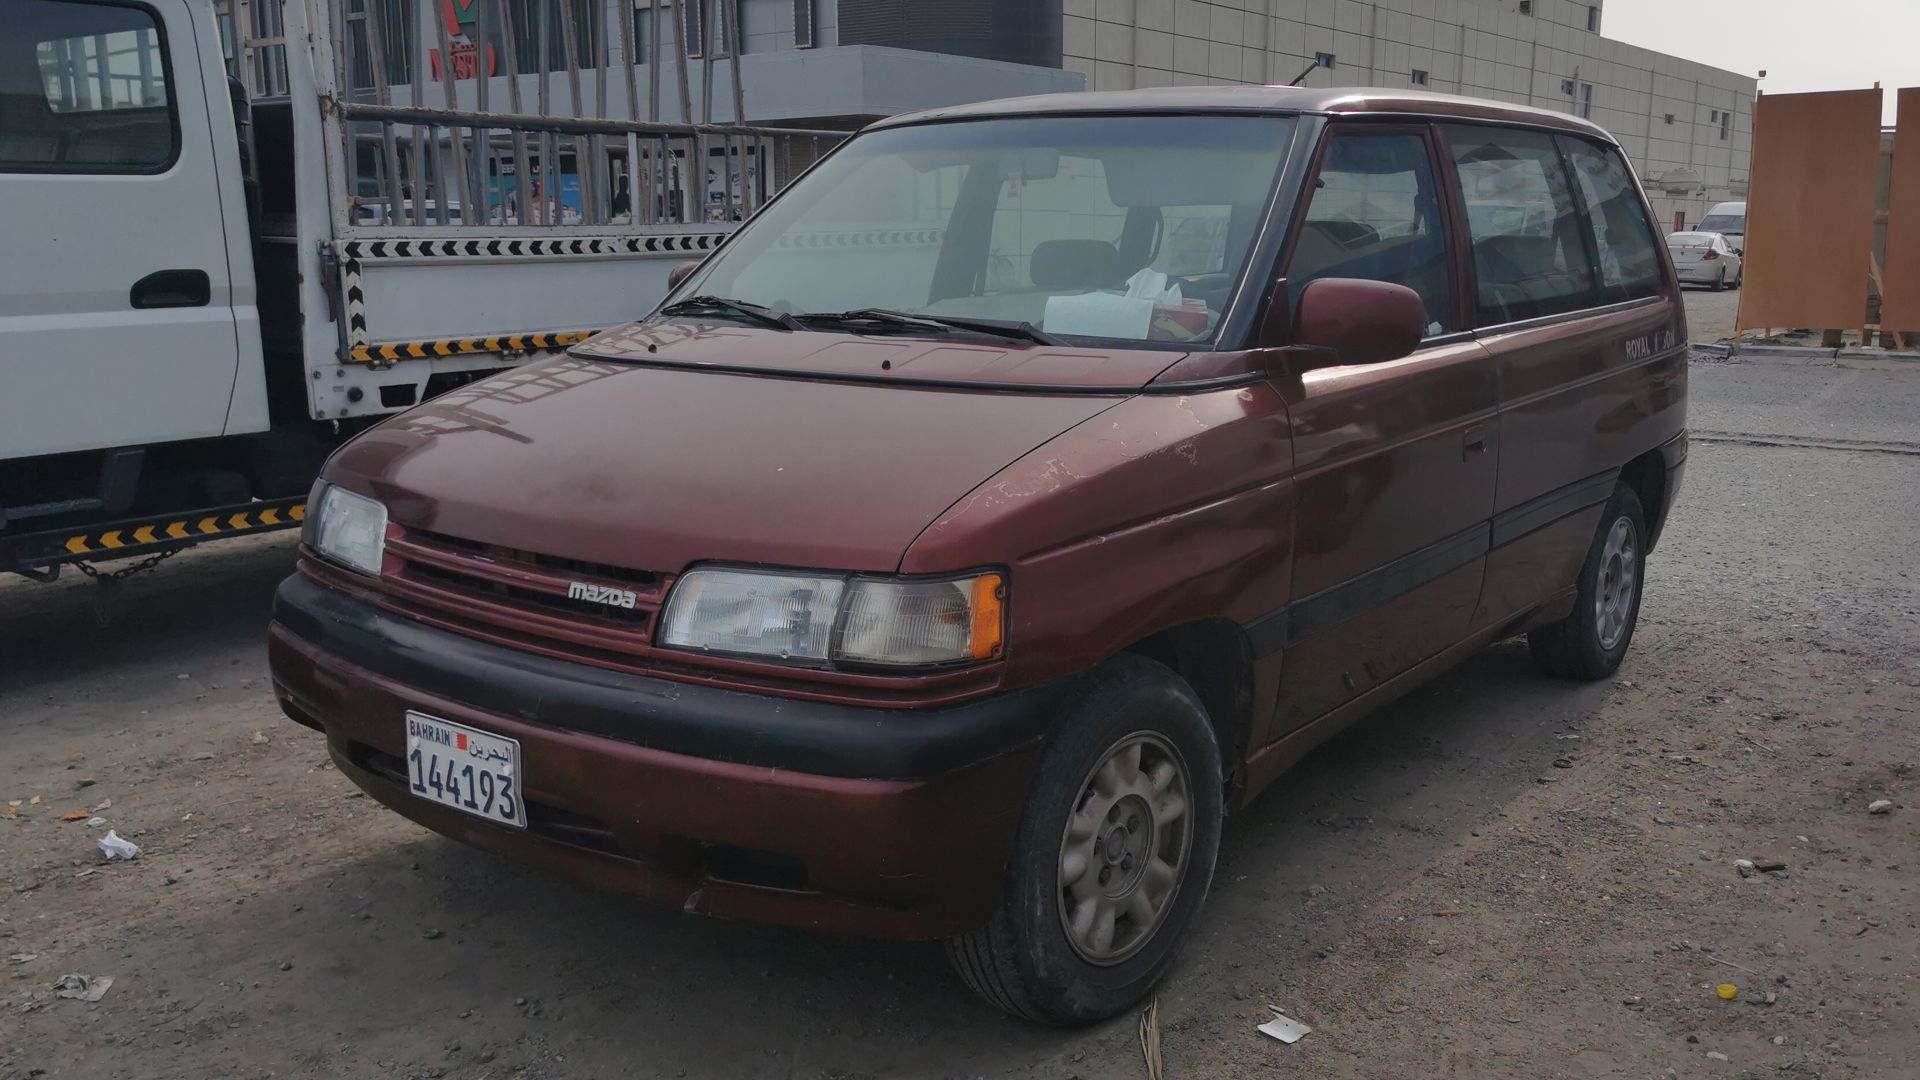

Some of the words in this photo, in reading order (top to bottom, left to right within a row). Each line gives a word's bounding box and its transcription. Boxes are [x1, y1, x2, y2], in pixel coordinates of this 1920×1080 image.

[429, 41, 495, 81] NSTO
[1626, 336, 1651, 361] ROYAL
[409, 719, 450, 746] BAHRAIN
[469, 739, 512, 766] البحرين
[410, 748, 516, 820] 144193
